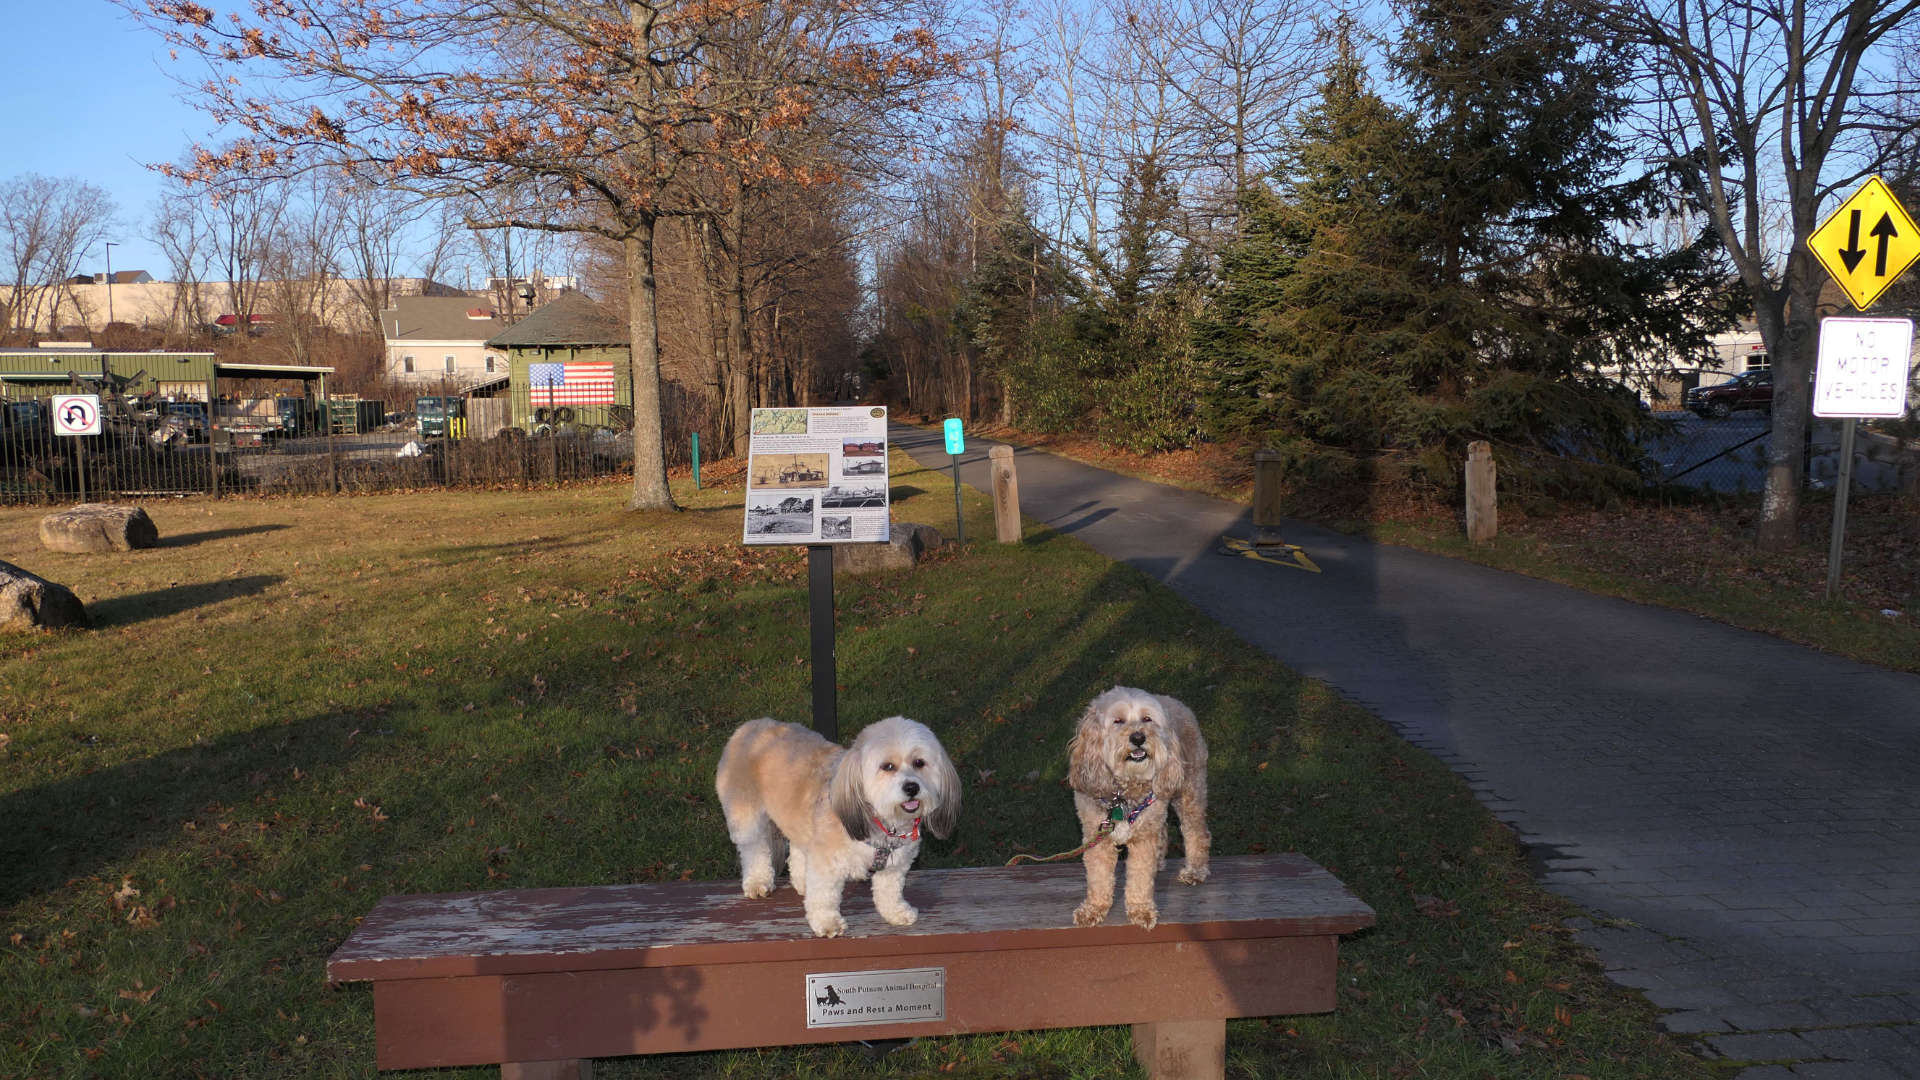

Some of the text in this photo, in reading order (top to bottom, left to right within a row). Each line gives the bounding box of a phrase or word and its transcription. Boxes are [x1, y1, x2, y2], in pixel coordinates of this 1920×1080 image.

[1856, 331, 1876, 348] NO
[1837, 356, 1890, 374] MOTOR
[1825, 382, 1897, 400] VEHCLES
[838, 986, 857, 994] South
[857, 985, 883, 993] Putnam
[885, 984, 908, 992] Animal
[822, 1008, 845, 1016] Paws
[847, 1006, 864, 1015] and
[866, 1005, 885, 1014] Rest
[896, 1003, 932, 1012] Moment
